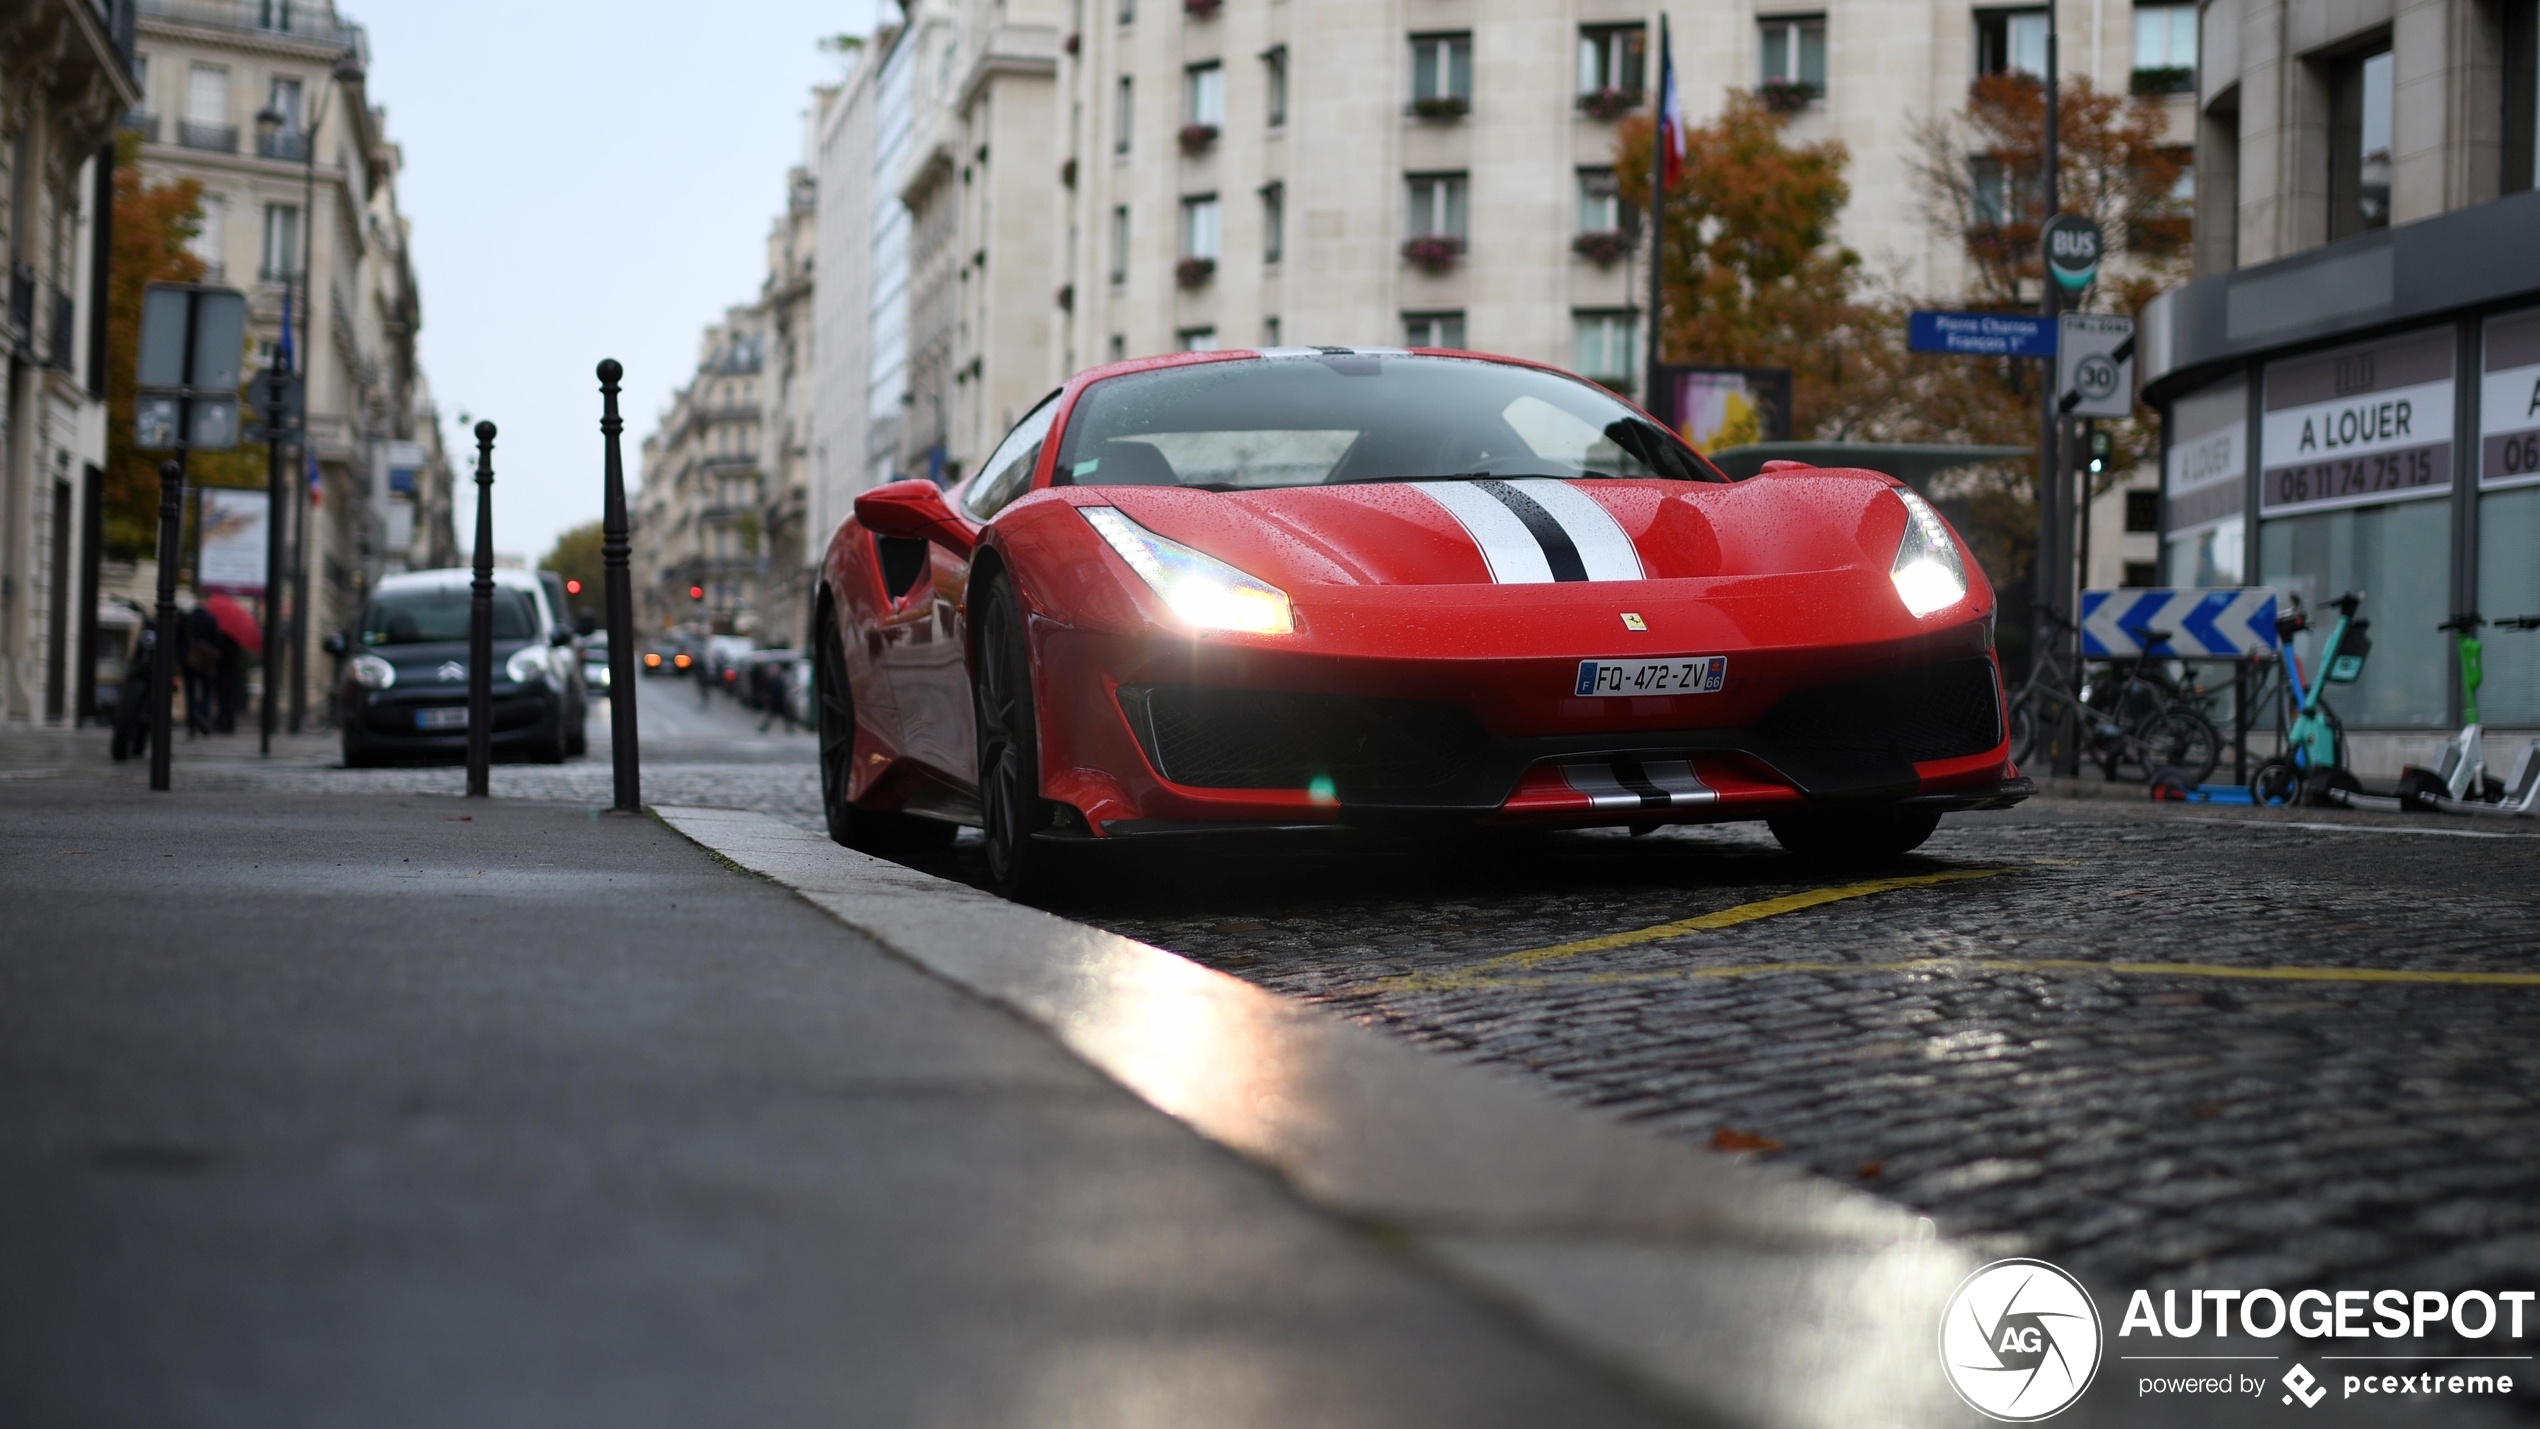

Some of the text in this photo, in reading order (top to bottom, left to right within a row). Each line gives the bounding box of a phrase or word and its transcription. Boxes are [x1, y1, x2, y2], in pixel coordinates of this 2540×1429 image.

[2053, 230, 2096, 256] BUS
[1936, 315, 2038, 336] Pierre Charron
[2083, 365, 2111, 387] 30
[2299, 399, 2413, 452] A LOUER
[2505, 436, 2539, 472] 06
[2280, 448, 2431, 501] 06 11 74 75 15
[1582, 681, 1590, 691] F
[1596, 663, 1705, 691] FQ-472-ZV
[1706, 676, 1720, 688] 66
